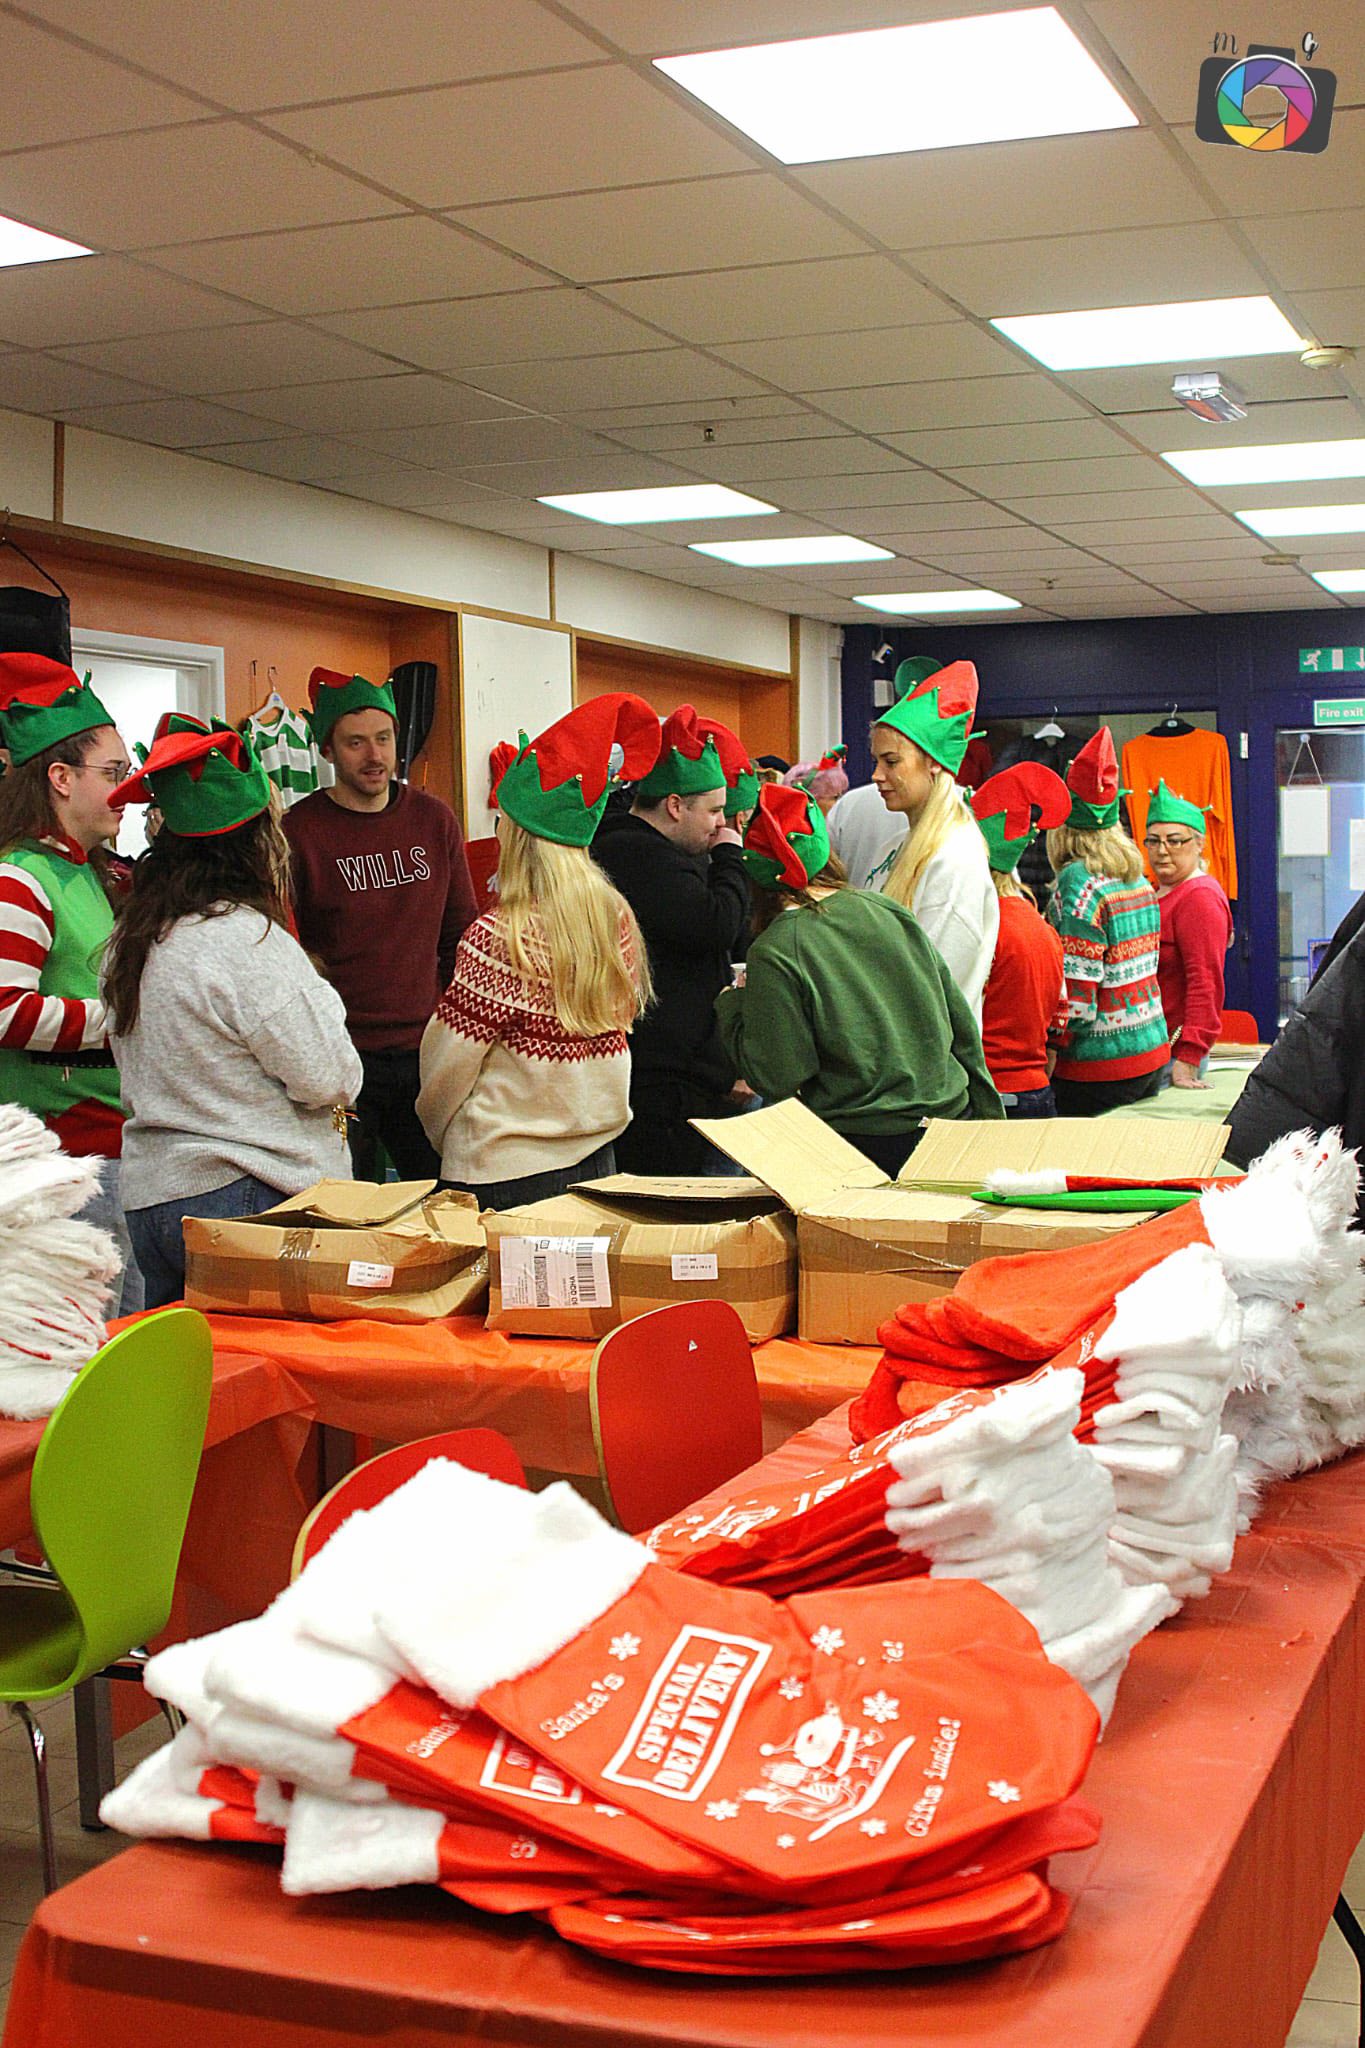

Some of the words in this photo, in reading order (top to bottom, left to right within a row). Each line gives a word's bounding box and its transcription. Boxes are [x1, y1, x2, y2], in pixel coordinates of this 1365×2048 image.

[1319, 707, 1340, 718] Fire
[1343, 706, 1364, 718] exit
[336, 846, 431, 892] WILLS
[539, 1672, 625, 1740] Santa's
[635, 1661, 705, 1764] SPECIAL
[652, 1645, 749, 1790] DELIVERY
[923, 1716, 961, 1781] inside!
[904, 1785, 944, 1838] Gifts
